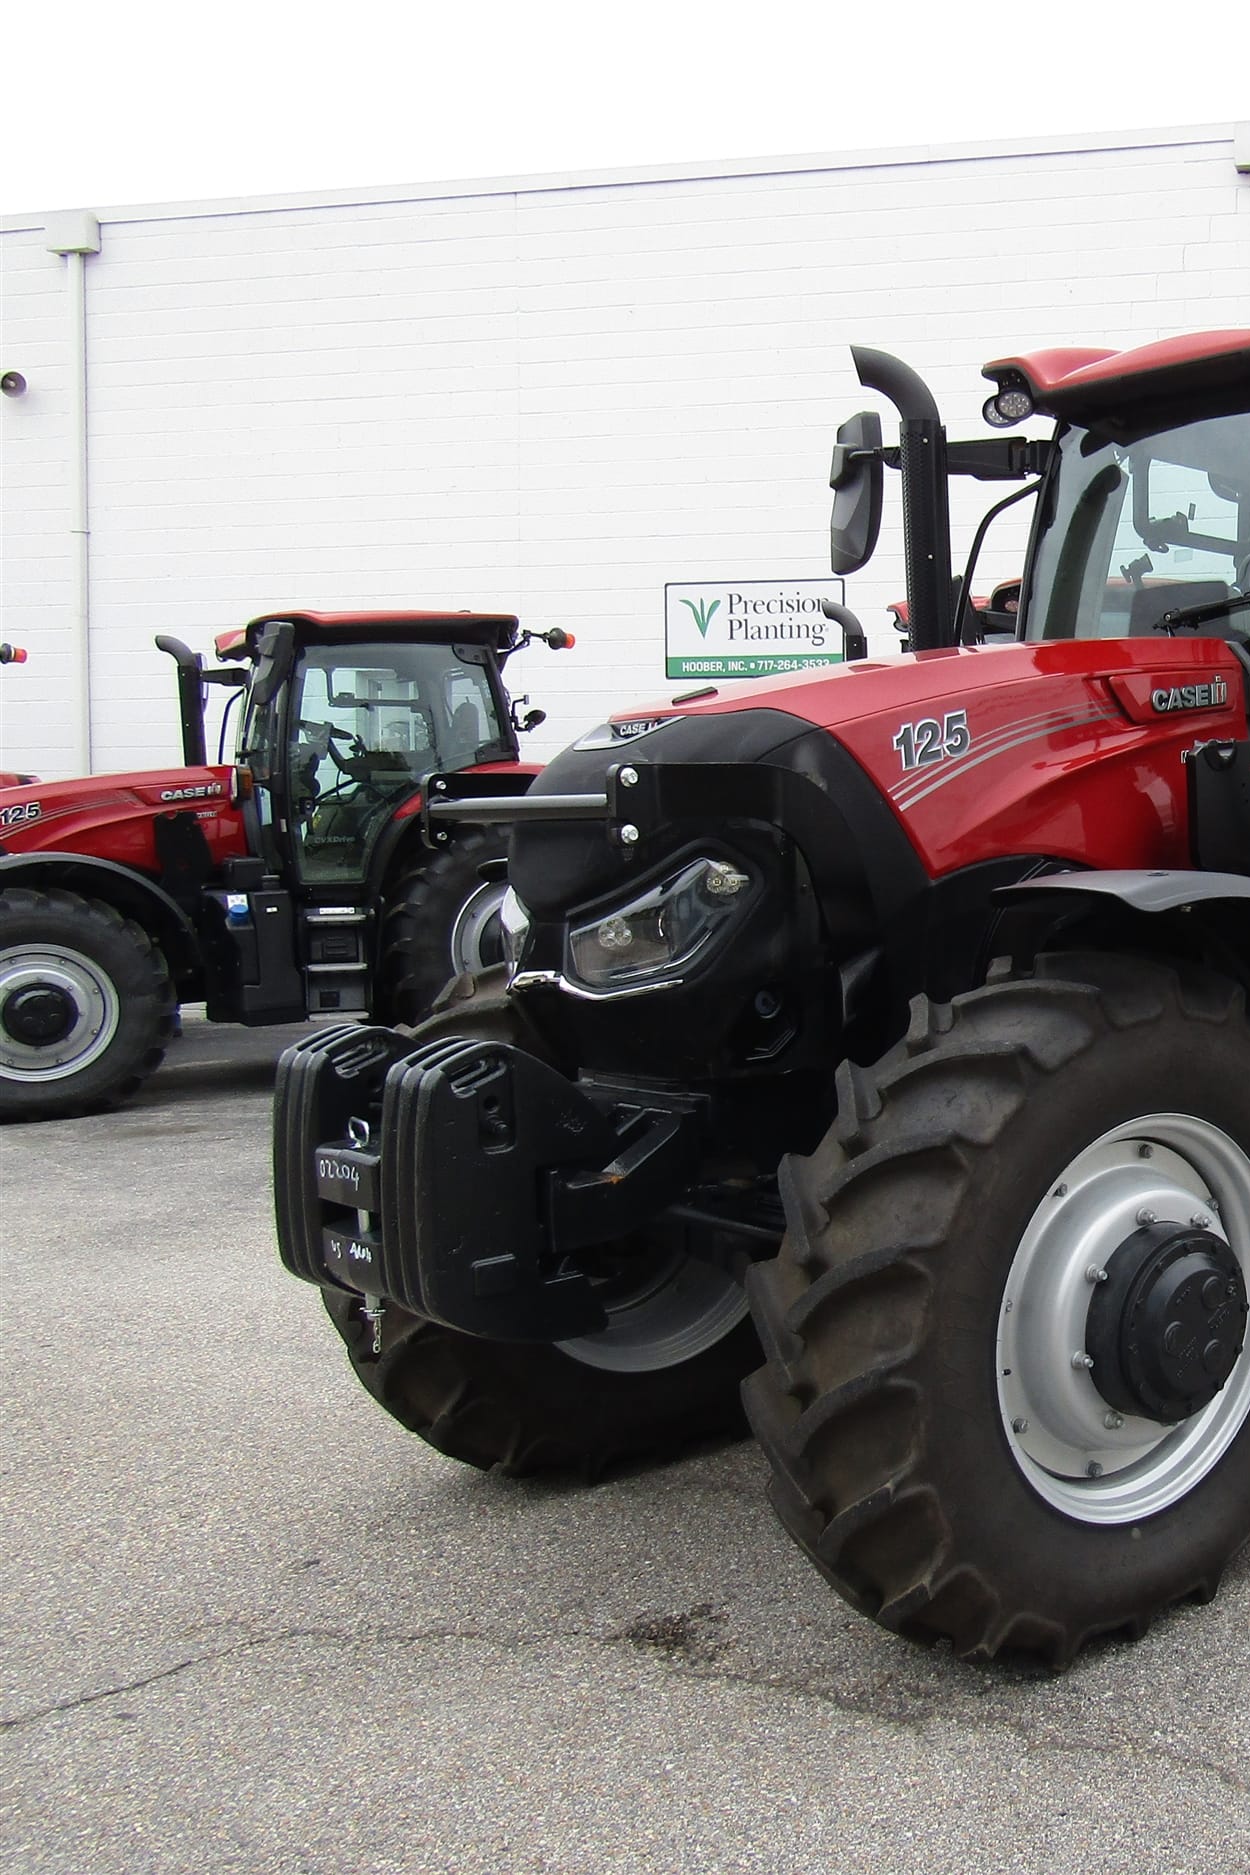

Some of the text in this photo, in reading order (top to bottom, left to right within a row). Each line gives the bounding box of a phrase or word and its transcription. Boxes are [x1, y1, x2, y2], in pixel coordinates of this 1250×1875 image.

[728, 592, 829, 615] Precision
[728, 618, 826, 646] Planting
[682, 661, 726, 673] HOOBER,
[728, 660, 748, 672] INC.
[1152, 684, 1209, 712] CASE
[620, 723, 646, 736] CASE
[893, 709, 971, 772] 125
[161, 787, 206, 801] CASE
[0, 801, 42, 826] 125
